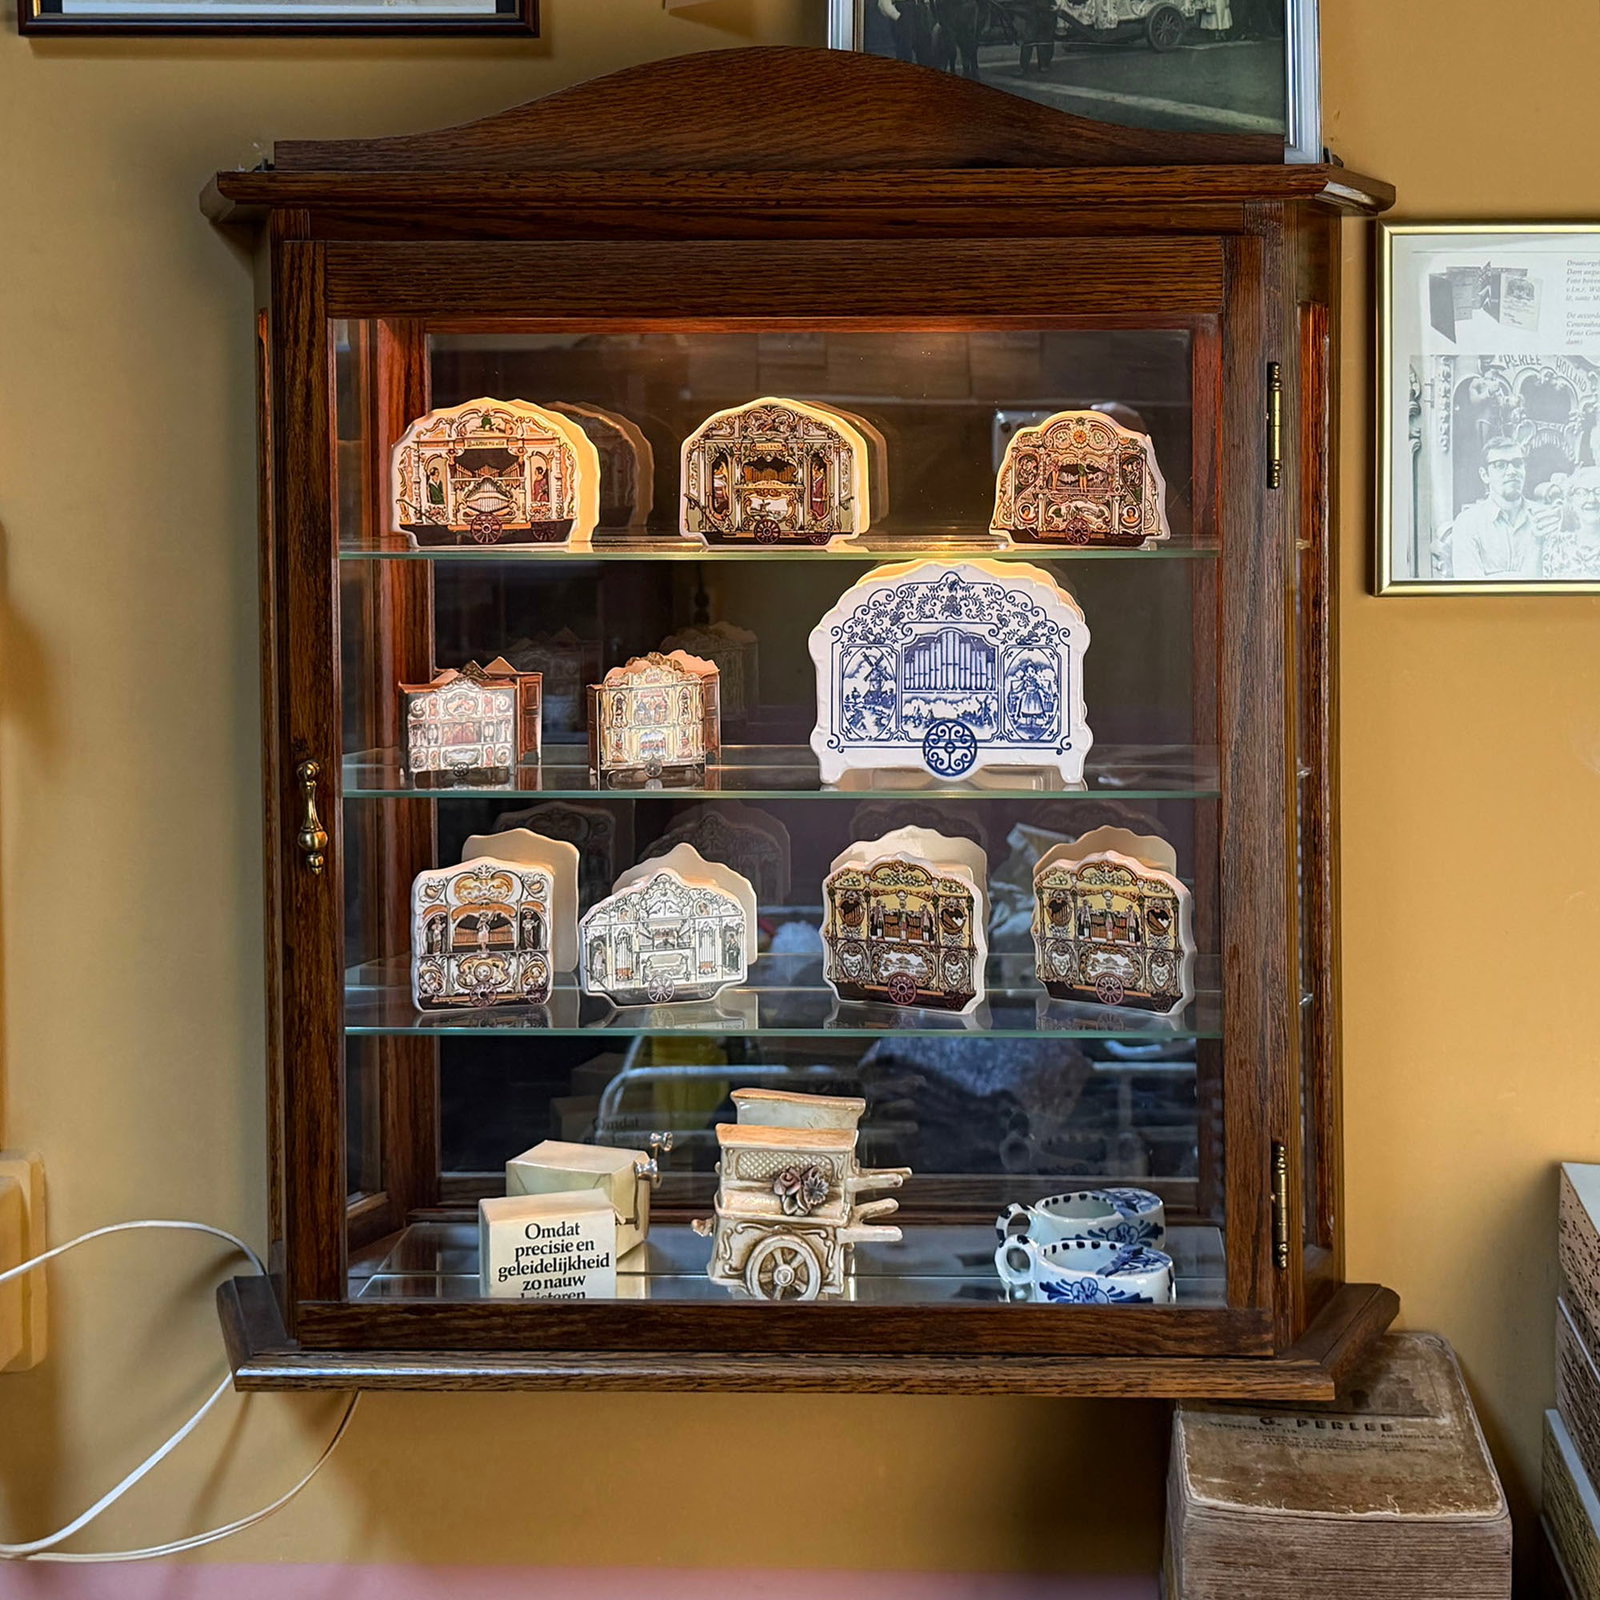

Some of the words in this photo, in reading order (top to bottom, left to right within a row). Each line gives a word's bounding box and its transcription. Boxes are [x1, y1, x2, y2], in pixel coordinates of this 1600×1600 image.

[525, 1221, 581, 1240] Omdat
[514, 1239, 574, 1262] precisie
[576, 1240, 595, 1252] en
[497, 1252, 610, 1282] geleidelijkheid
[522, 1279, 542, 1291] zo
[544, 1275, 586, 1289] nauw
[1296, 1418, 1394, 1432] PERLEE
